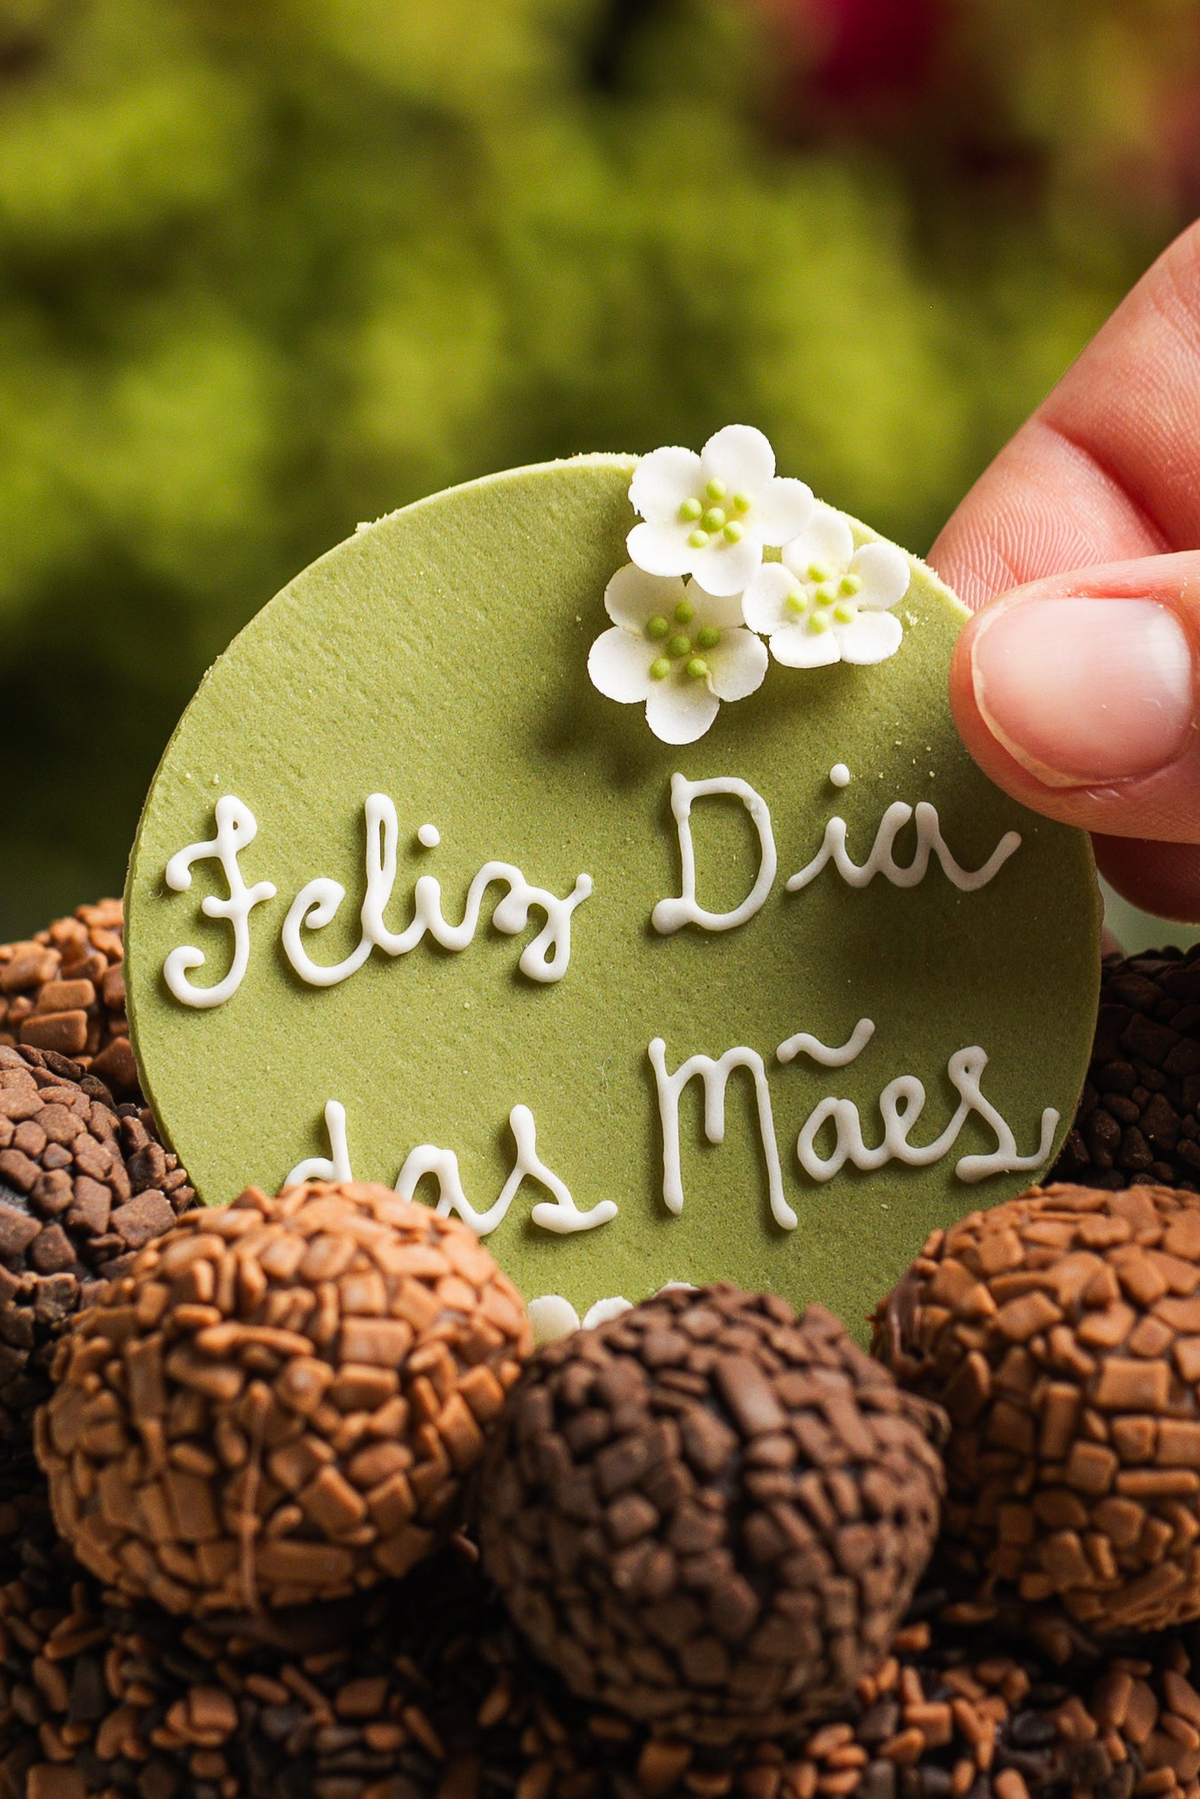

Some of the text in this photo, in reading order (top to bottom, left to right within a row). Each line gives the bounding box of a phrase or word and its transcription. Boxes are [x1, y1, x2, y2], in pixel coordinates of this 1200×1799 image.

[163, 763, 1023, 1009] Feliz Dia
[648, 1018, 1060, 1231] Mães
